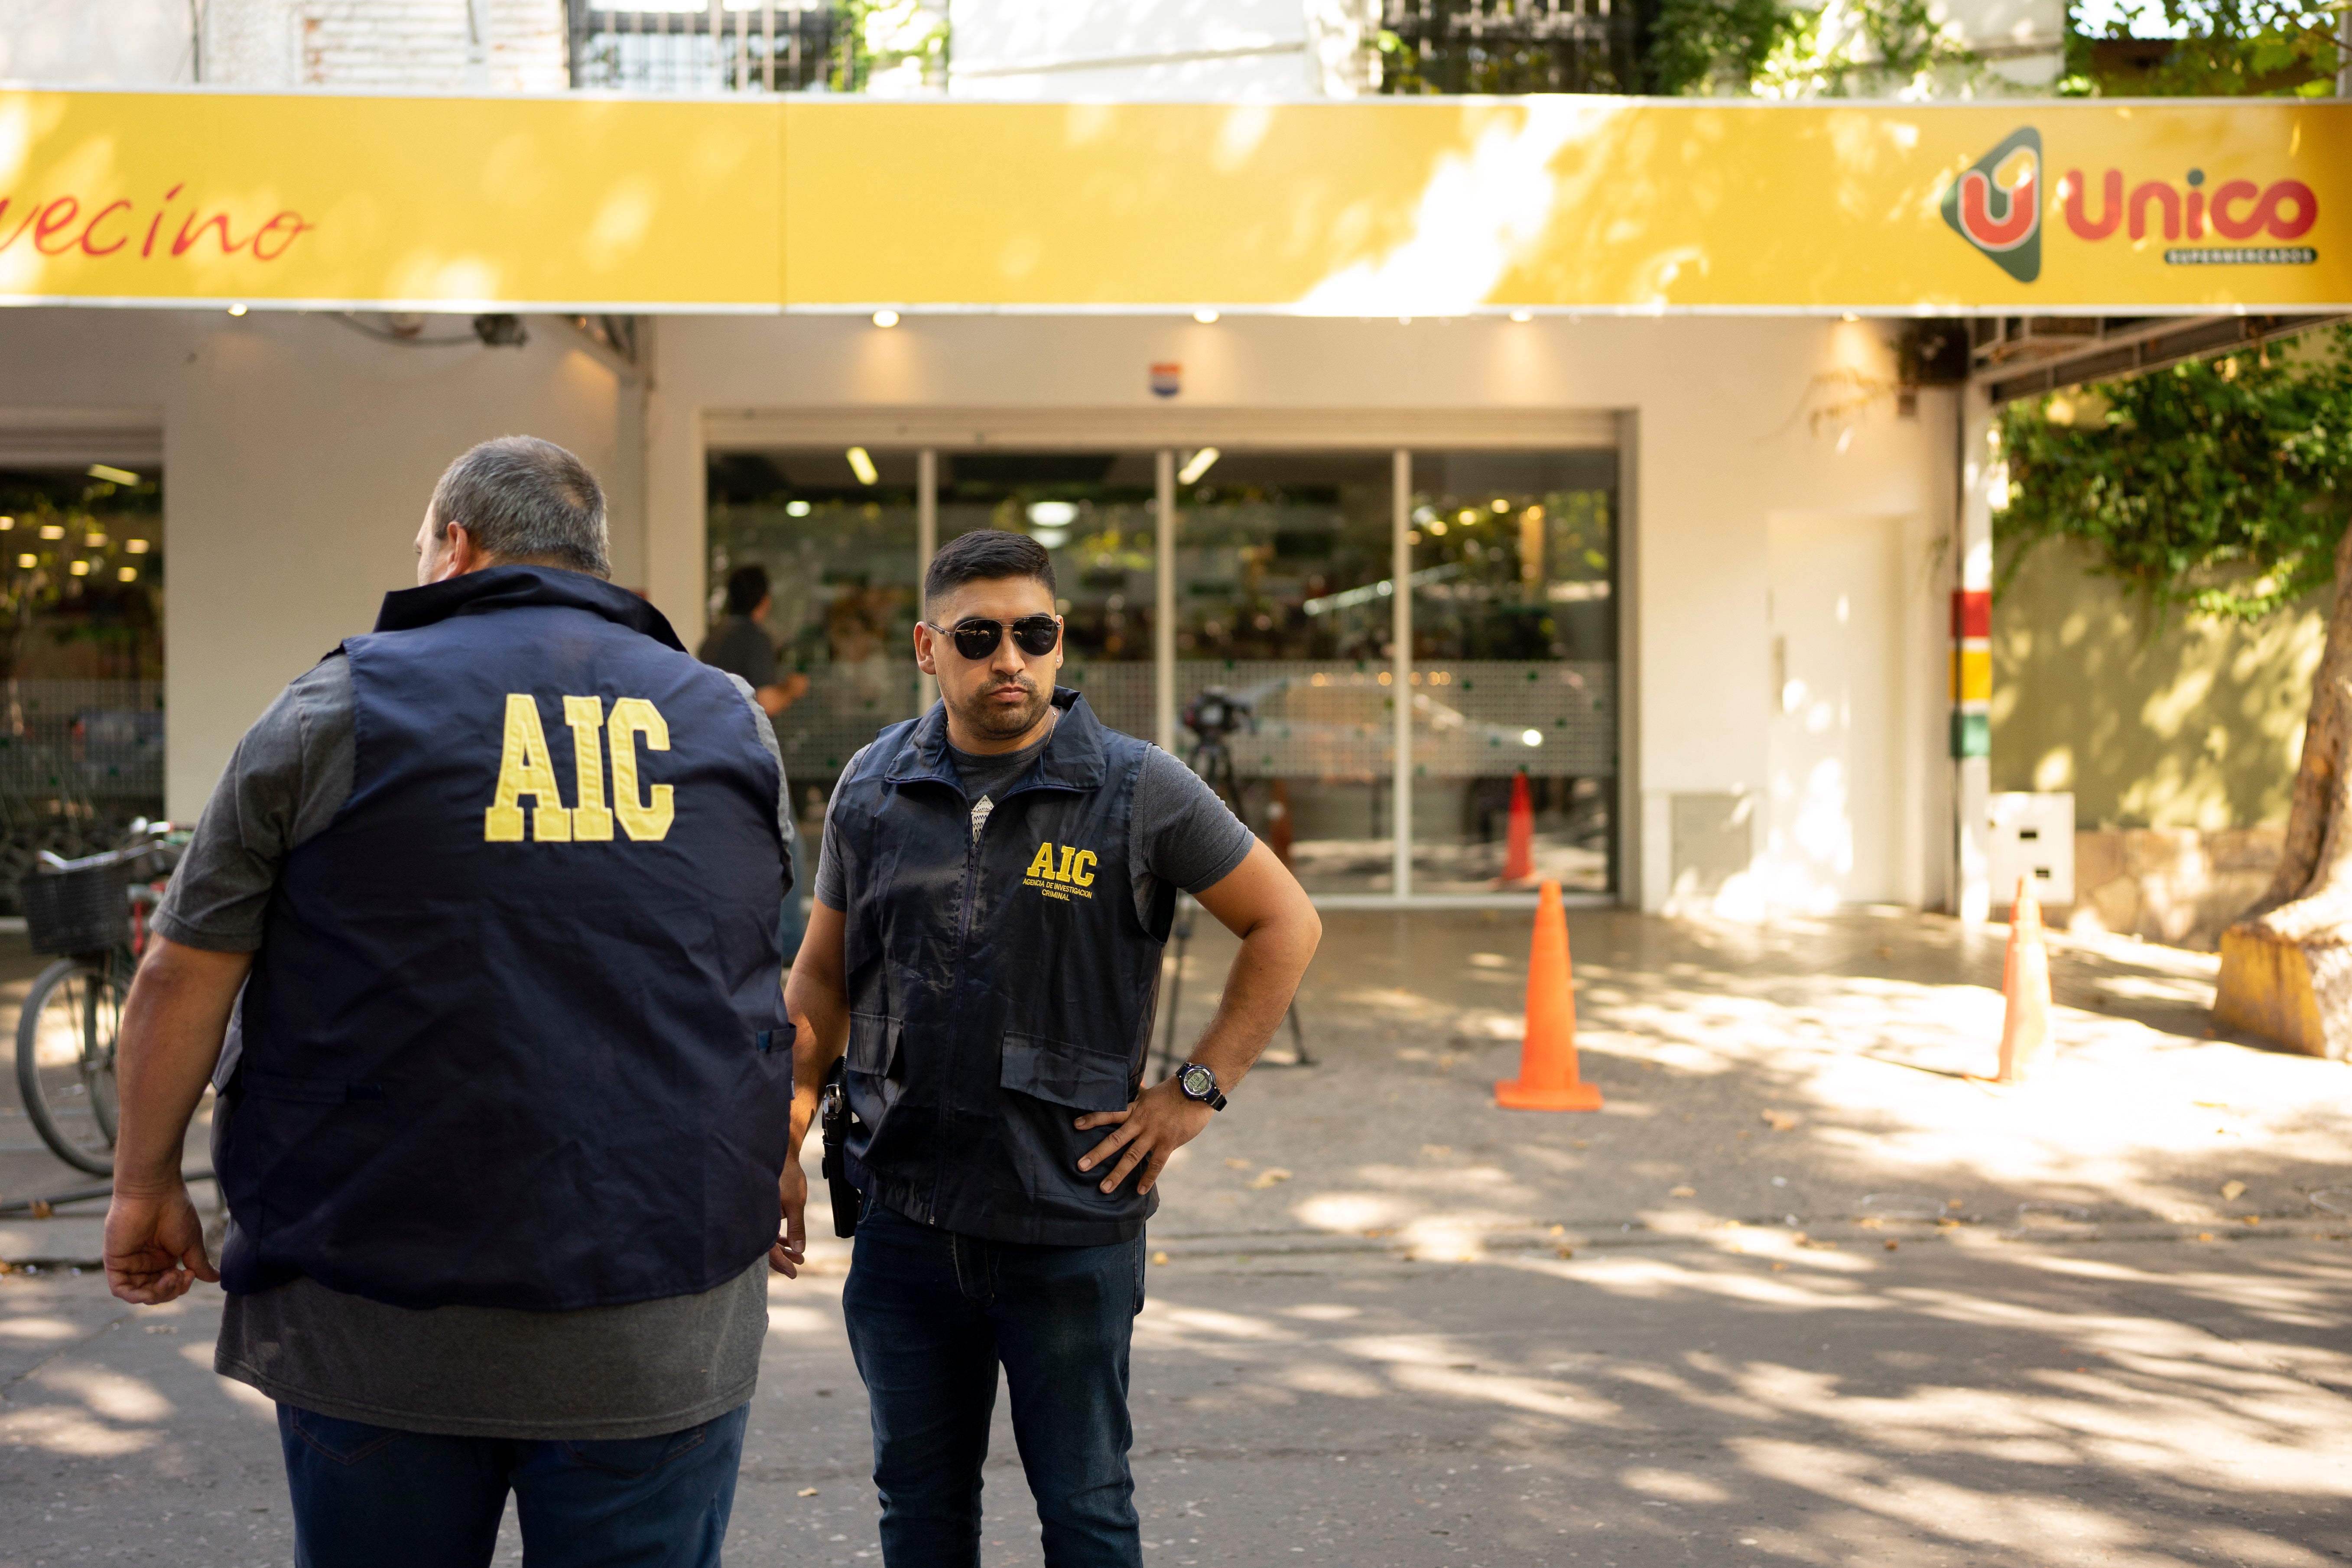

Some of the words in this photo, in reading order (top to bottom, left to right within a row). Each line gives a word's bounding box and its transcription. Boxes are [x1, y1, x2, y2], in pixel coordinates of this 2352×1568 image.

[484, 693, 675, 842] AIC
[1026, 842, 1098, 887] AIC
[1023, 878, 1045, 887] AGENCIA
[1054, 883, 1092, 899] INVESTIGACION
[1042, 889, 1070, 901] CRIMINAL
